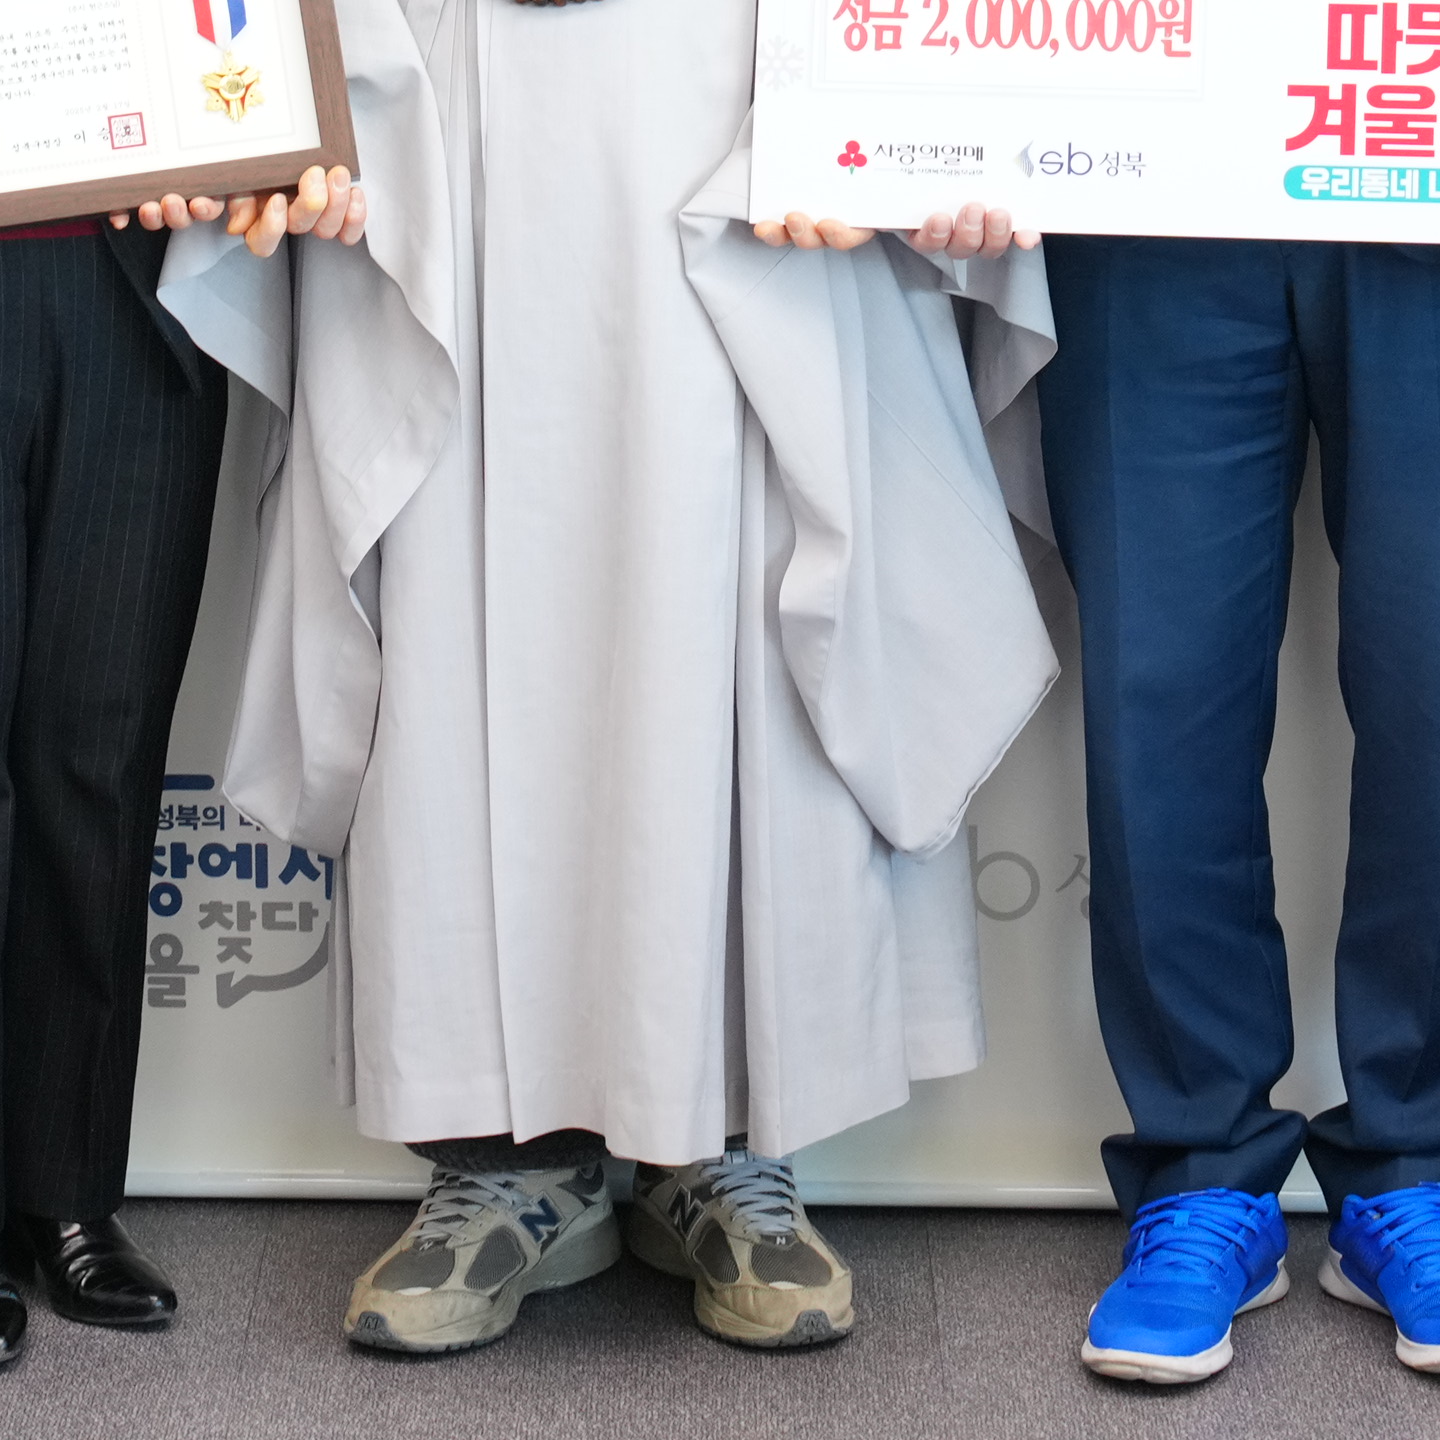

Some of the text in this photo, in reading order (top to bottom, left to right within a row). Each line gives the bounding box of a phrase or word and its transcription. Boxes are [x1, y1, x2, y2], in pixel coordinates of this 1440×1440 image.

[874, 144, 983, 165] 사랑의열매
[1039, 142, 1146, 177] sb 성북
[1301, 167, 1419, 199] 우리동네
[149, 842, 333, 917] 장에서
[198, 900, 319, 965] 찾다
